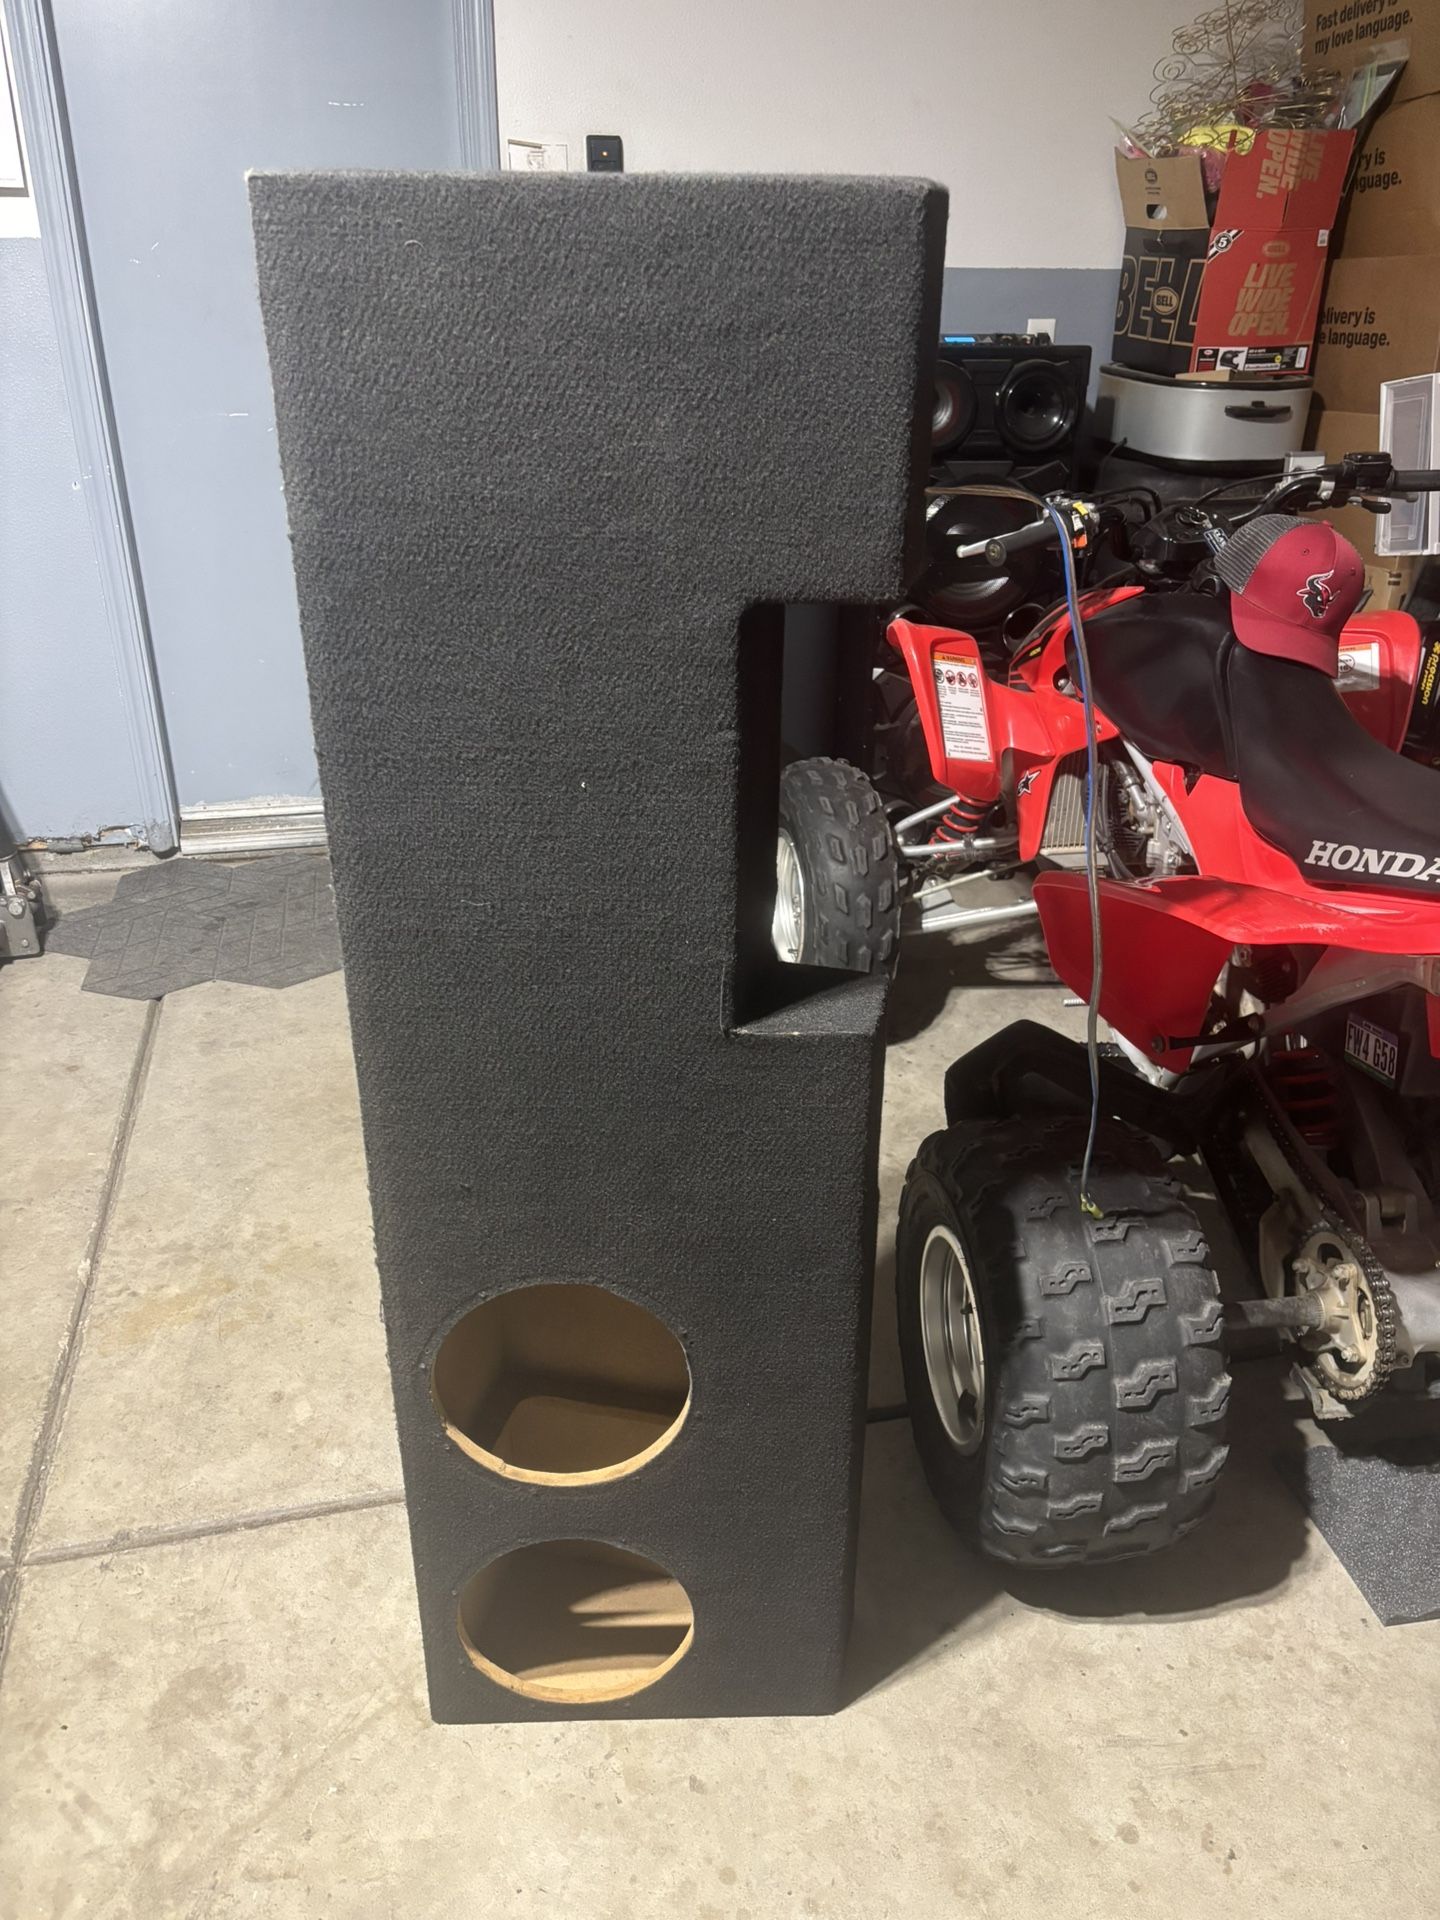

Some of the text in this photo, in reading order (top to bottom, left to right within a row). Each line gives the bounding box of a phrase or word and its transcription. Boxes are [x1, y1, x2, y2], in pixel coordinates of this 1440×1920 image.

[1316, 0, 1386, 32] Fast delivery
[1315, 9, 1413, 55] my love language.
[1255, 130, 1290, 199] OPEN.
[1374, 148, 1386, 166] is
[1352, 171, 1402, 193] nguage.
[1218, 237, 1228, 248] 5
[1243, 263, 1297, 288] LIVE
[1113, 255, 1207, 347] BELL
[1156, 295, 1173, 307] BELL
[1235, 288, 1296, 312] WIDE
[1227, 312, 1290, 336] OPEN.
[1320, 306, 1376, 328] elivery is
[1328, 327, 1390, 349] language.
[1304, 839, 1440, 884] HONDA
[1347, 1022, 1369, 1062] FW4
[1373, 1038, 1396, 1076] G58
